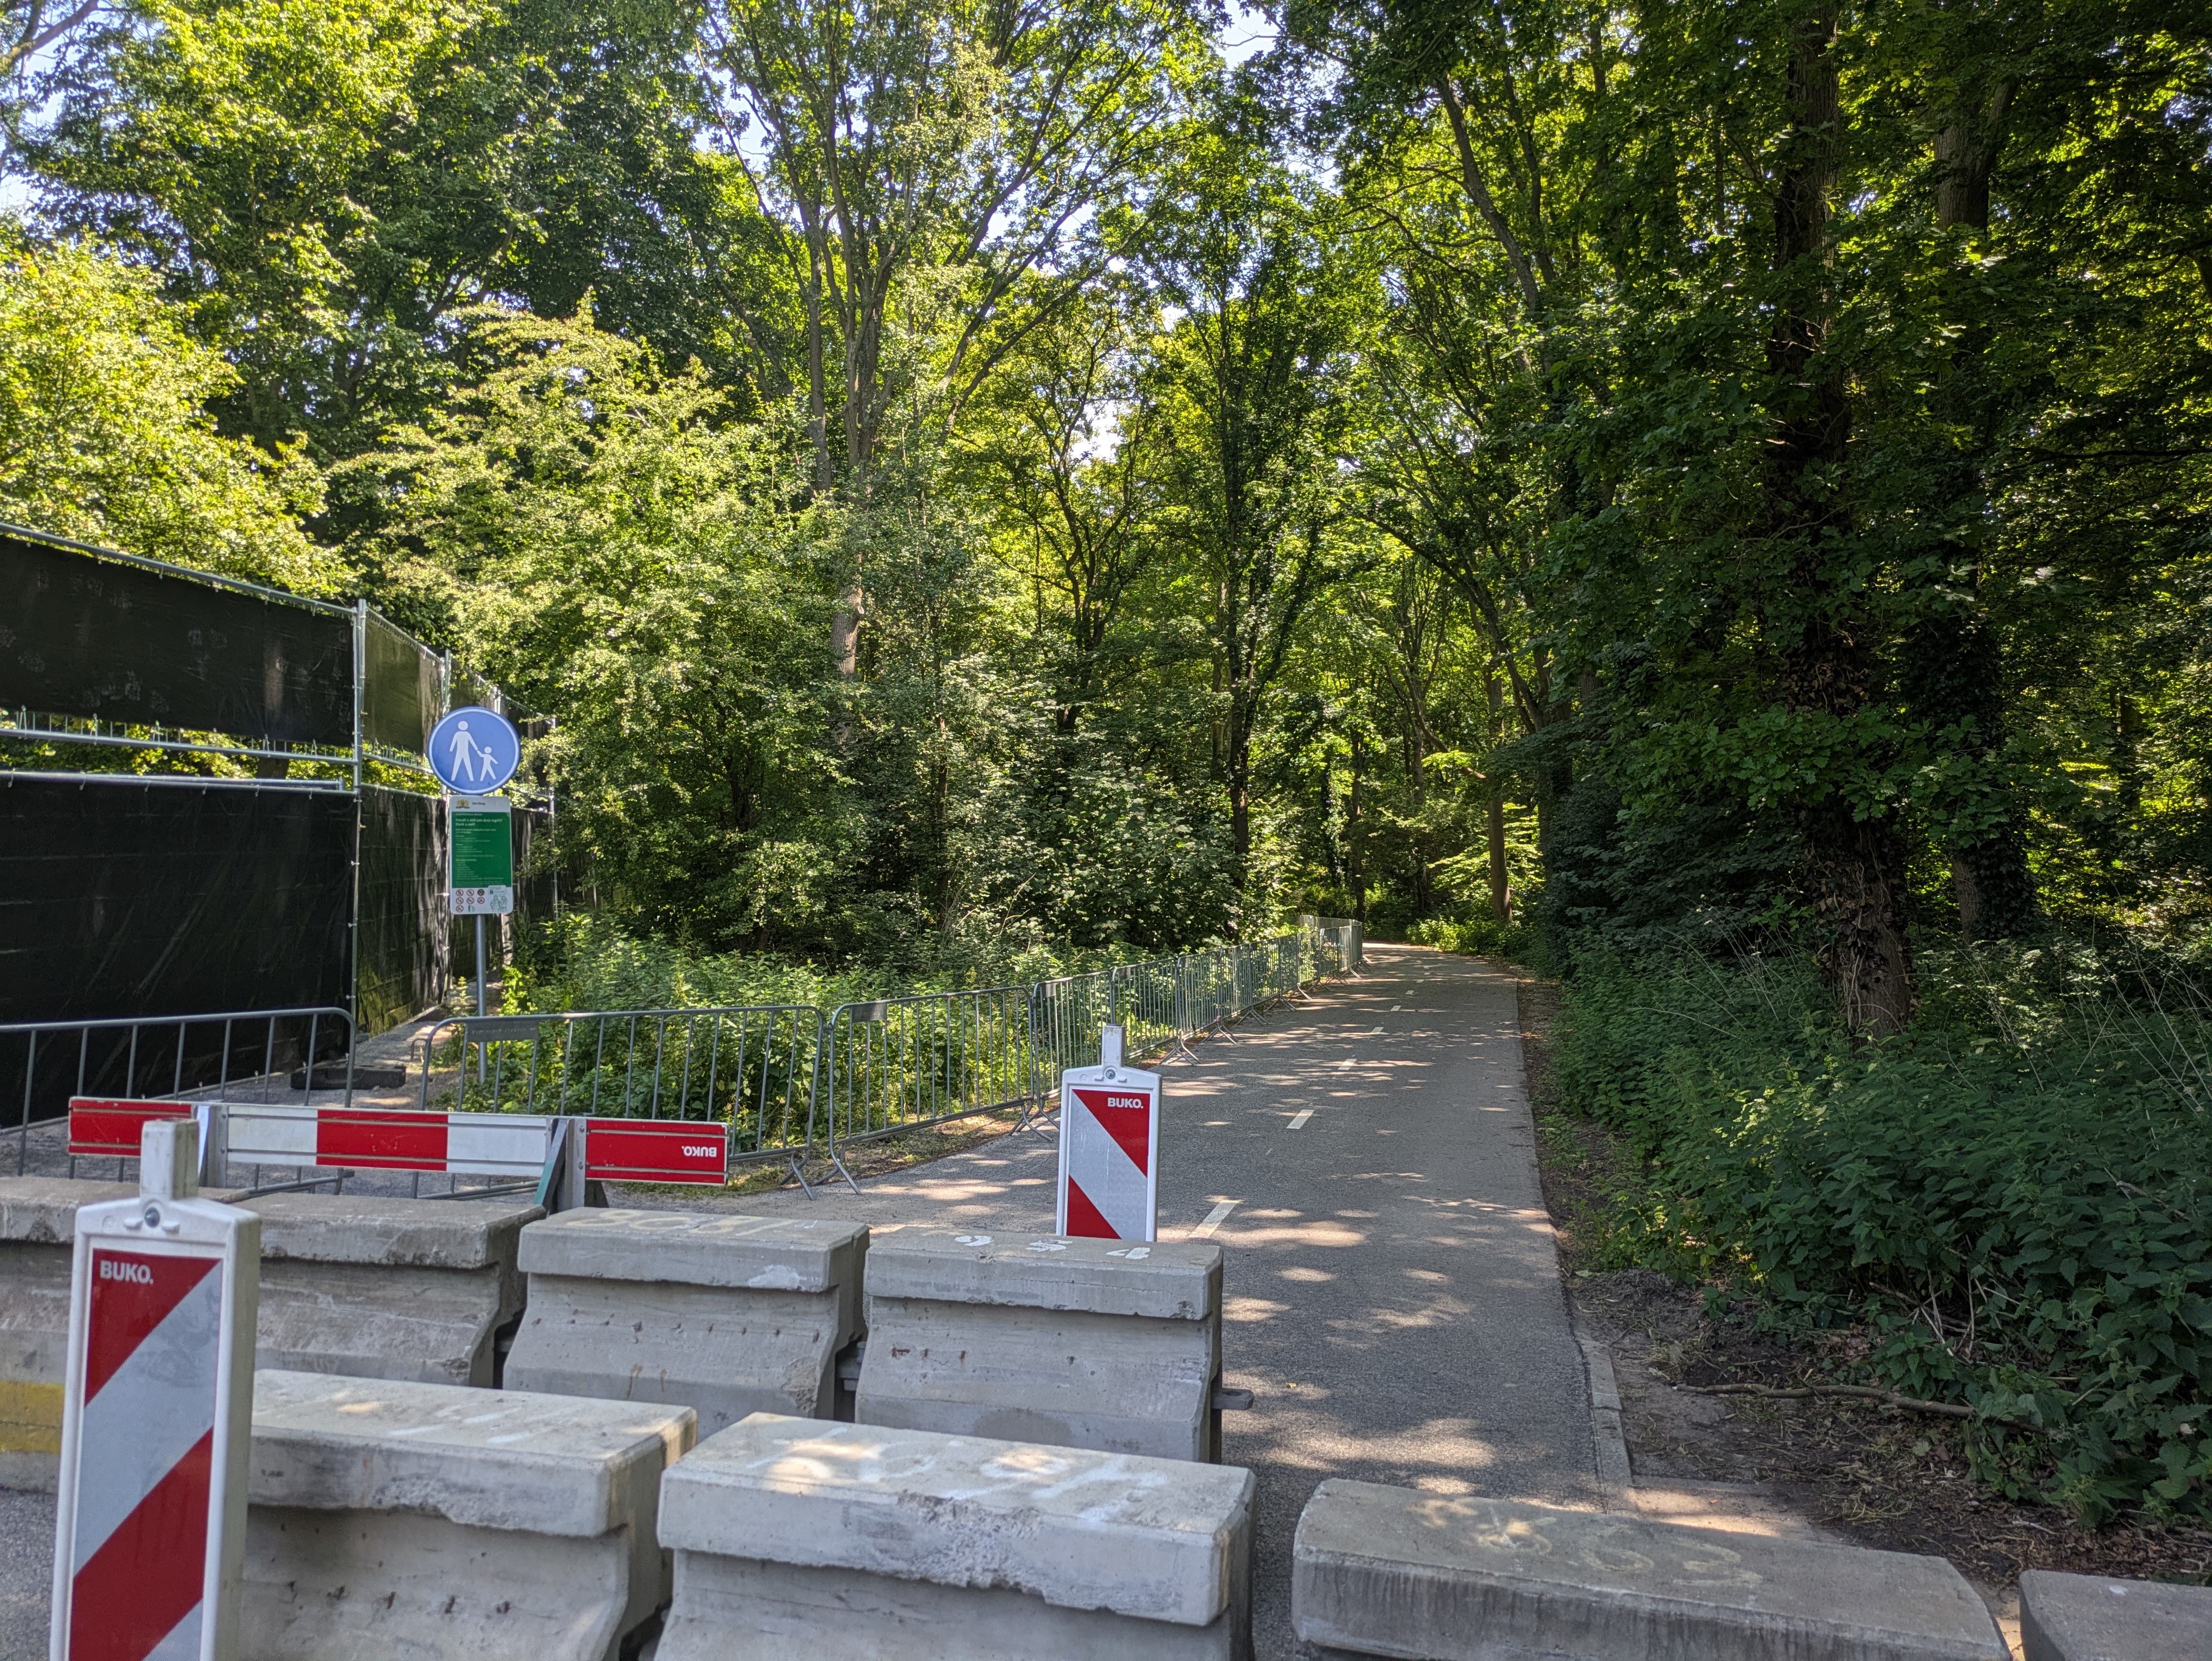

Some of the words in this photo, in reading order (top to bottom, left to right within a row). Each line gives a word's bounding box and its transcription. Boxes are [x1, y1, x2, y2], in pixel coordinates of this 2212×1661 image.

[1107, 1097, 1144, 1109] BUKO.
[681, 1146, 717, 1158] BUKO.
[100, 1260, 154, 1285] BUKO.
